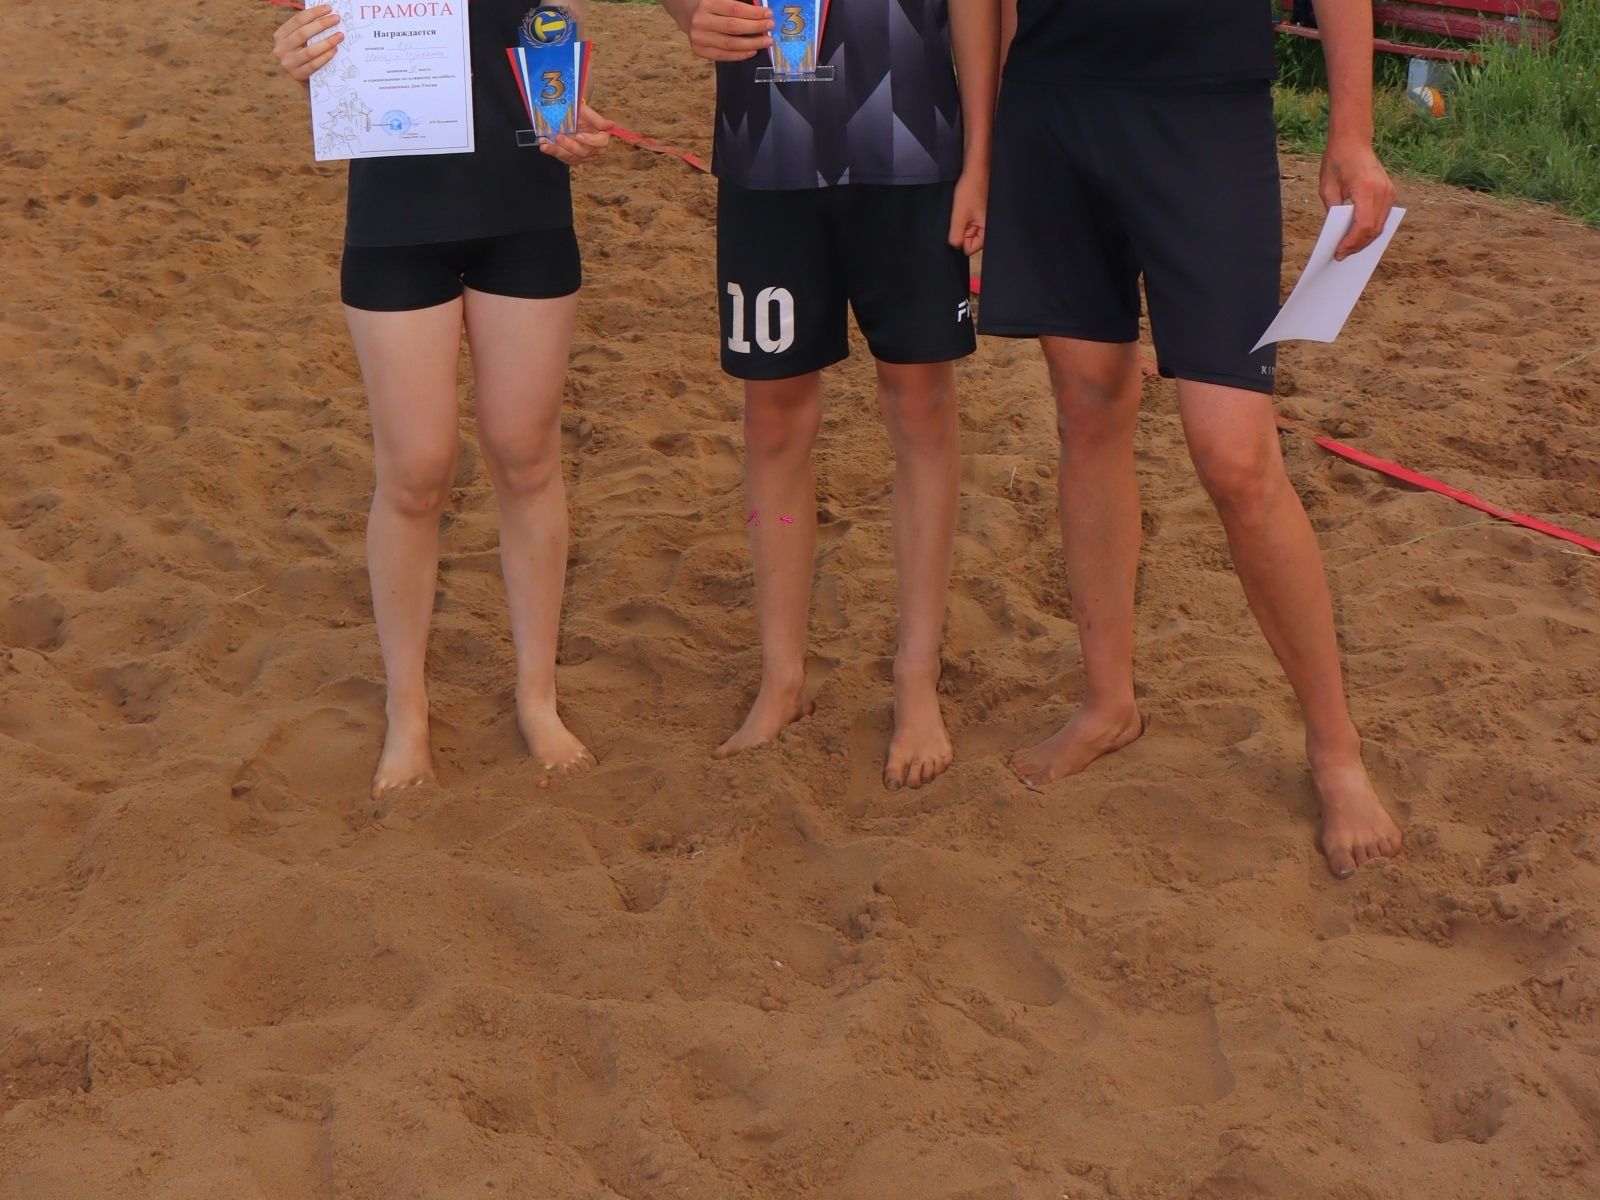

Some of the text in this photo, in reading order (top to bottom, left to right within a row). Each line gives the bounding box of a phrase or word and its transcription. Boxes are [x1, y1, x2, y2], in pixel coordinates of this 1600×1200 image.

[360, 1, 453, 19] ГРАМОТА
[780, 5, 806, 36] 3
[373, 29, 436, 39] Награждается
[540, 70, 566, 100] 3
[727, 282, 795, 353] 10
